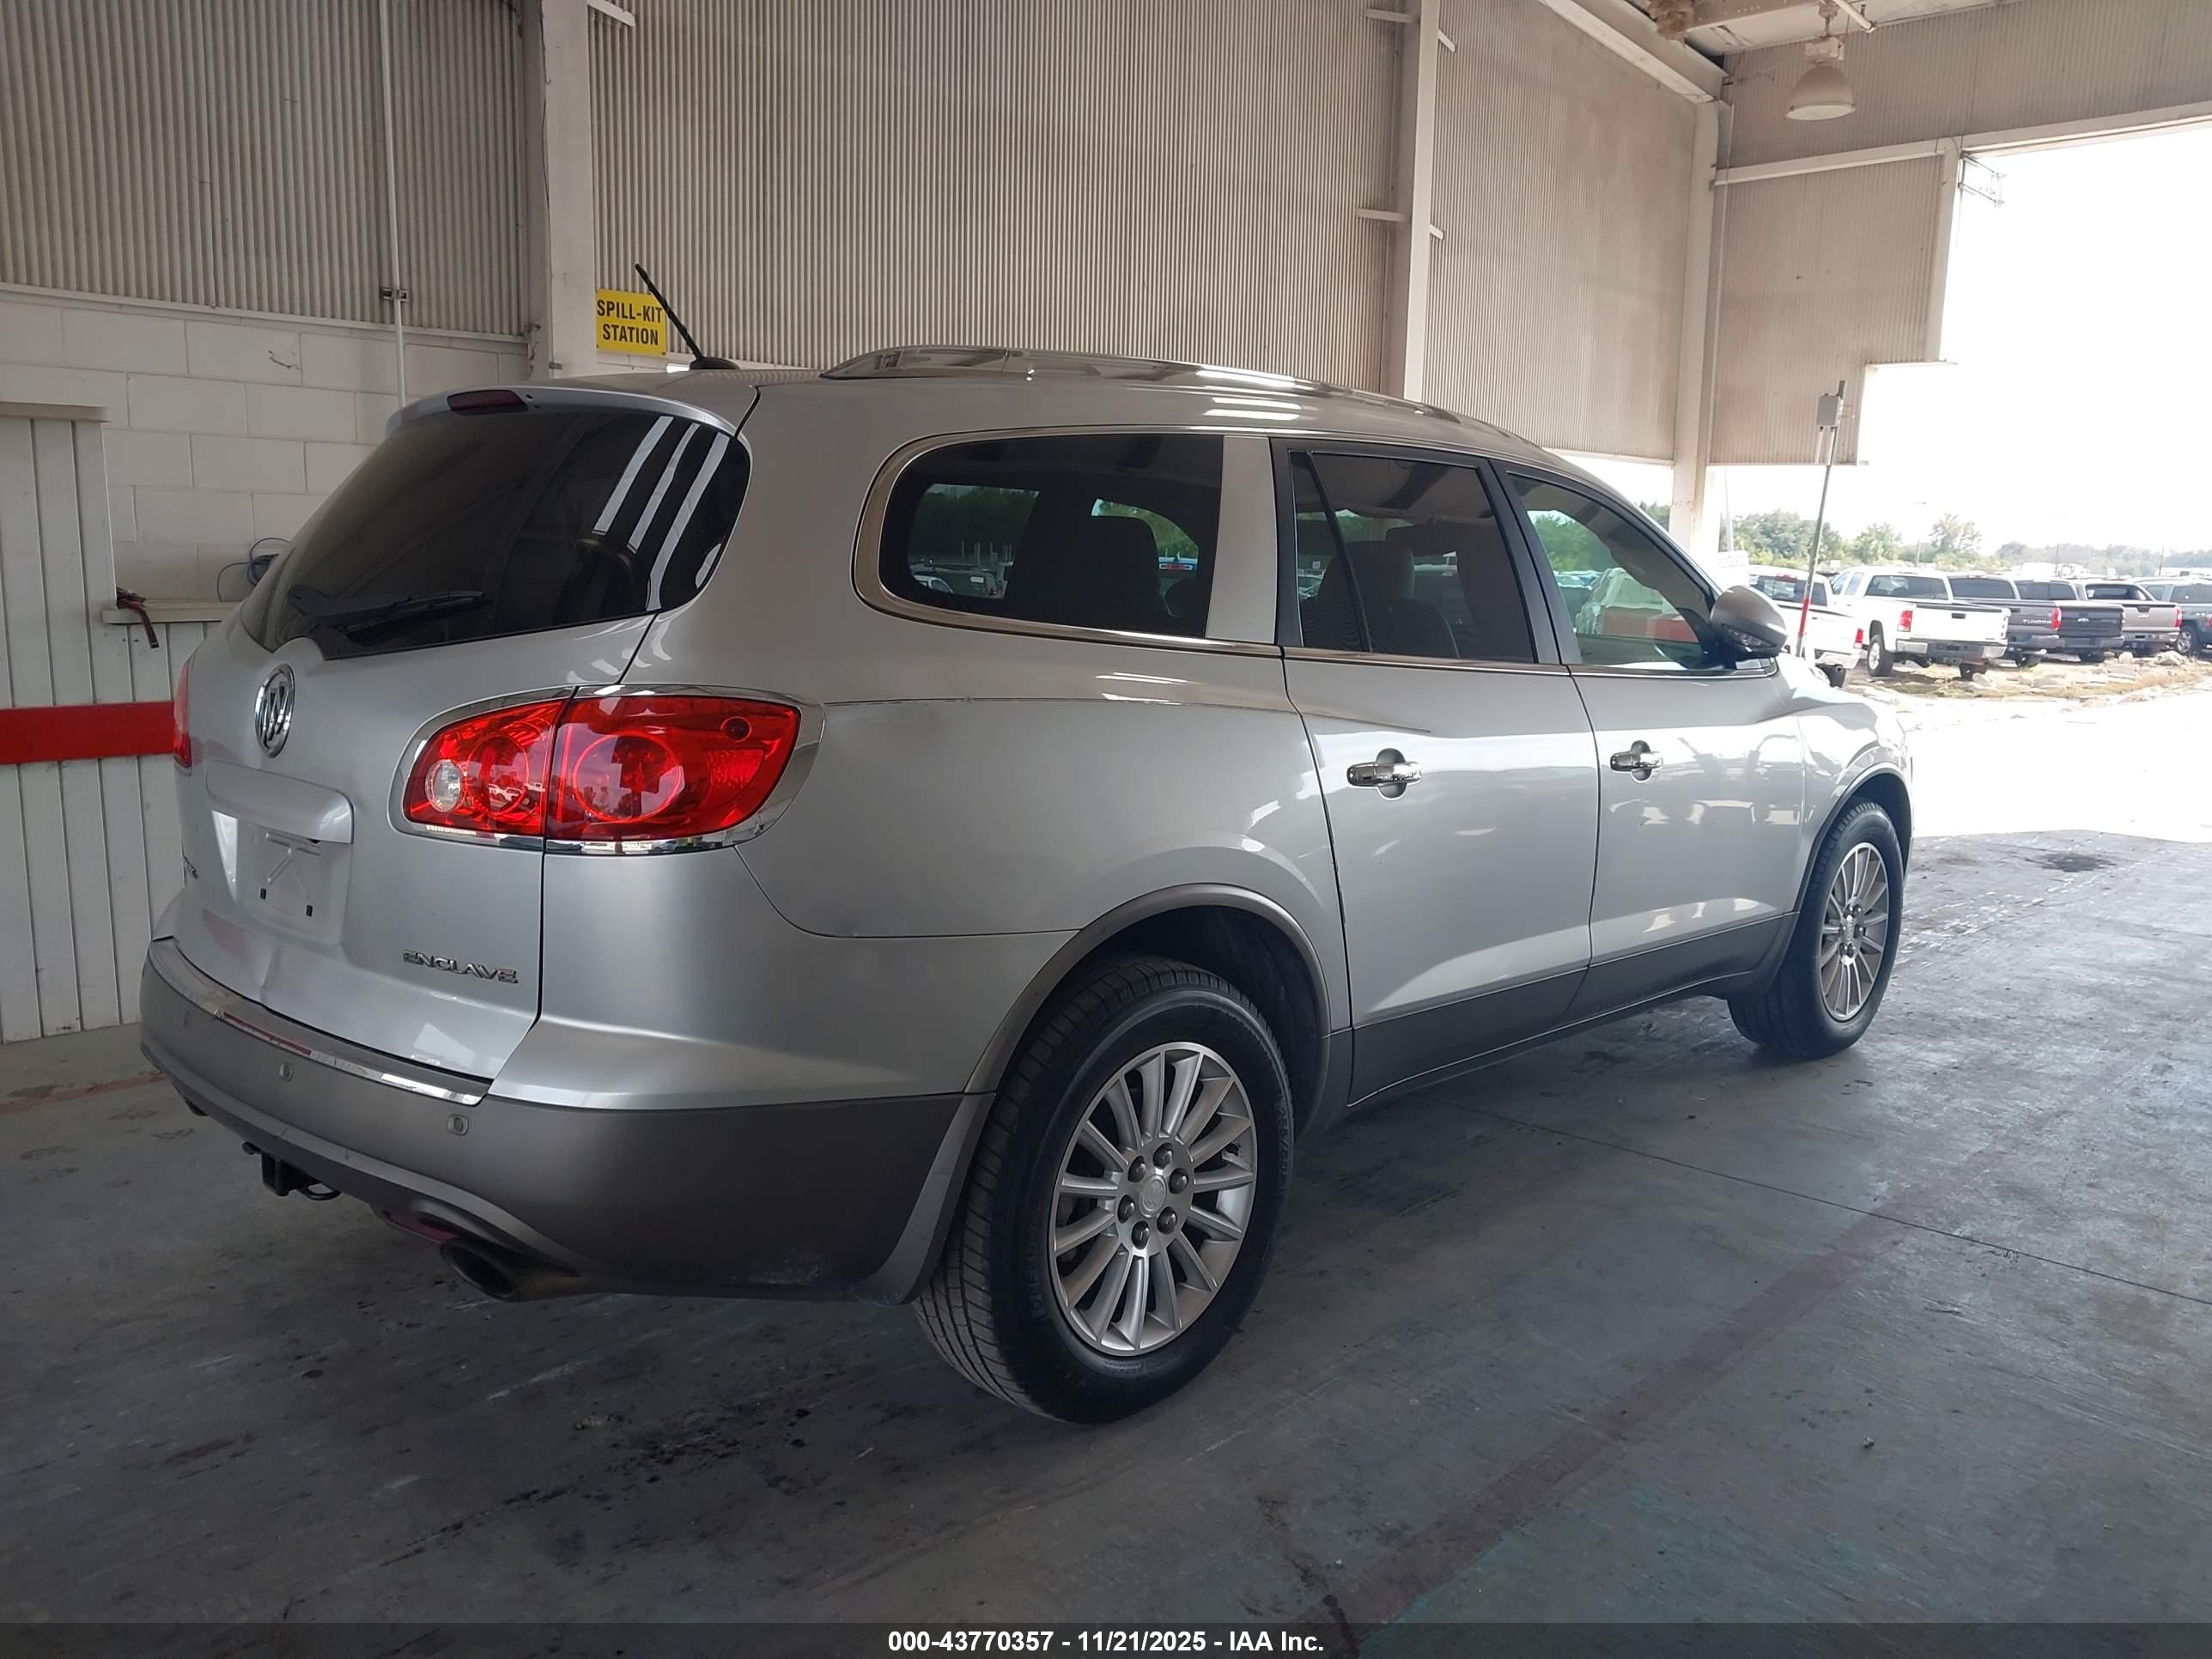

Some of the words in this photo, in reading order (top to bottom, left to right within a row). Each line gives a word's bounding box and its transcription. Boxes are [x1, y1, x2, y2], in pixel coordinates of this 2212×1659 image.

[597, 300, 662, 324] SPILL-KIT
[603, 323, 659, 346] STATION
[403, 949, 518, 984] ENCLAVE
